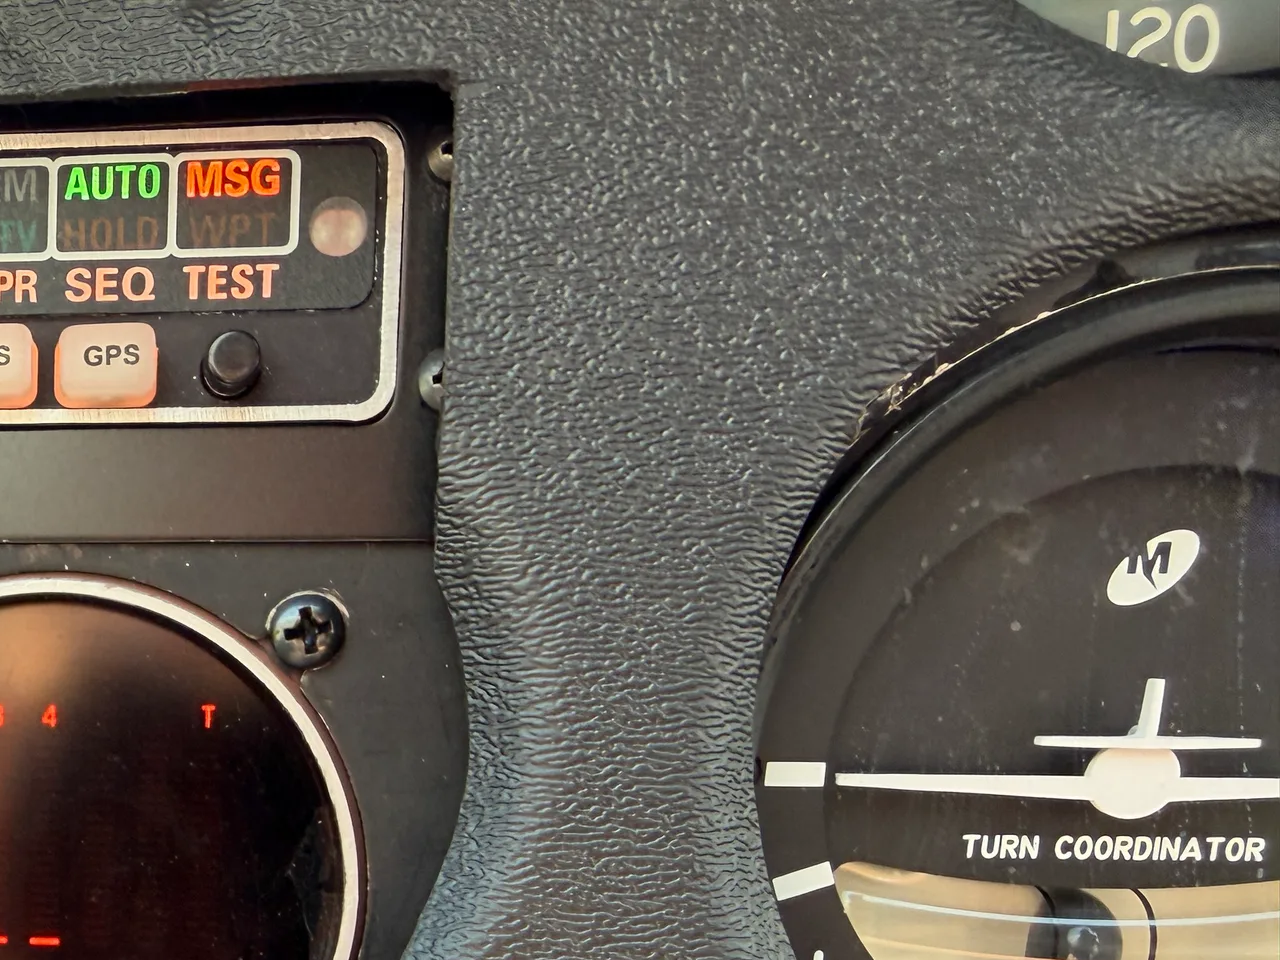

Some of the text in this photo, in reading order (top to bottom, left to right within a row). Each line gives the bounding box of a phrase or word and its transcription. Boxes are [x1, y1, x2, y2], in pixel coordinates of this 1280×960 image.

[1105, 3, 1220, 73] 120
[64, 163, 161, 200] AUTO
[185, 158, 281, 198] MSG
[61, 216, 160, 251] HOLD
[189, 211, 278, 248] WPT
[64, 266, 156, 303] SEQ
[183, 263, 280, 300] TEST
[83, 343, 141, 366] GPS
[41, 704, 58, 727] 4
[202, 703, 216, 728] T
[963, 833, 1265, 862] TURN COORDINATOR
